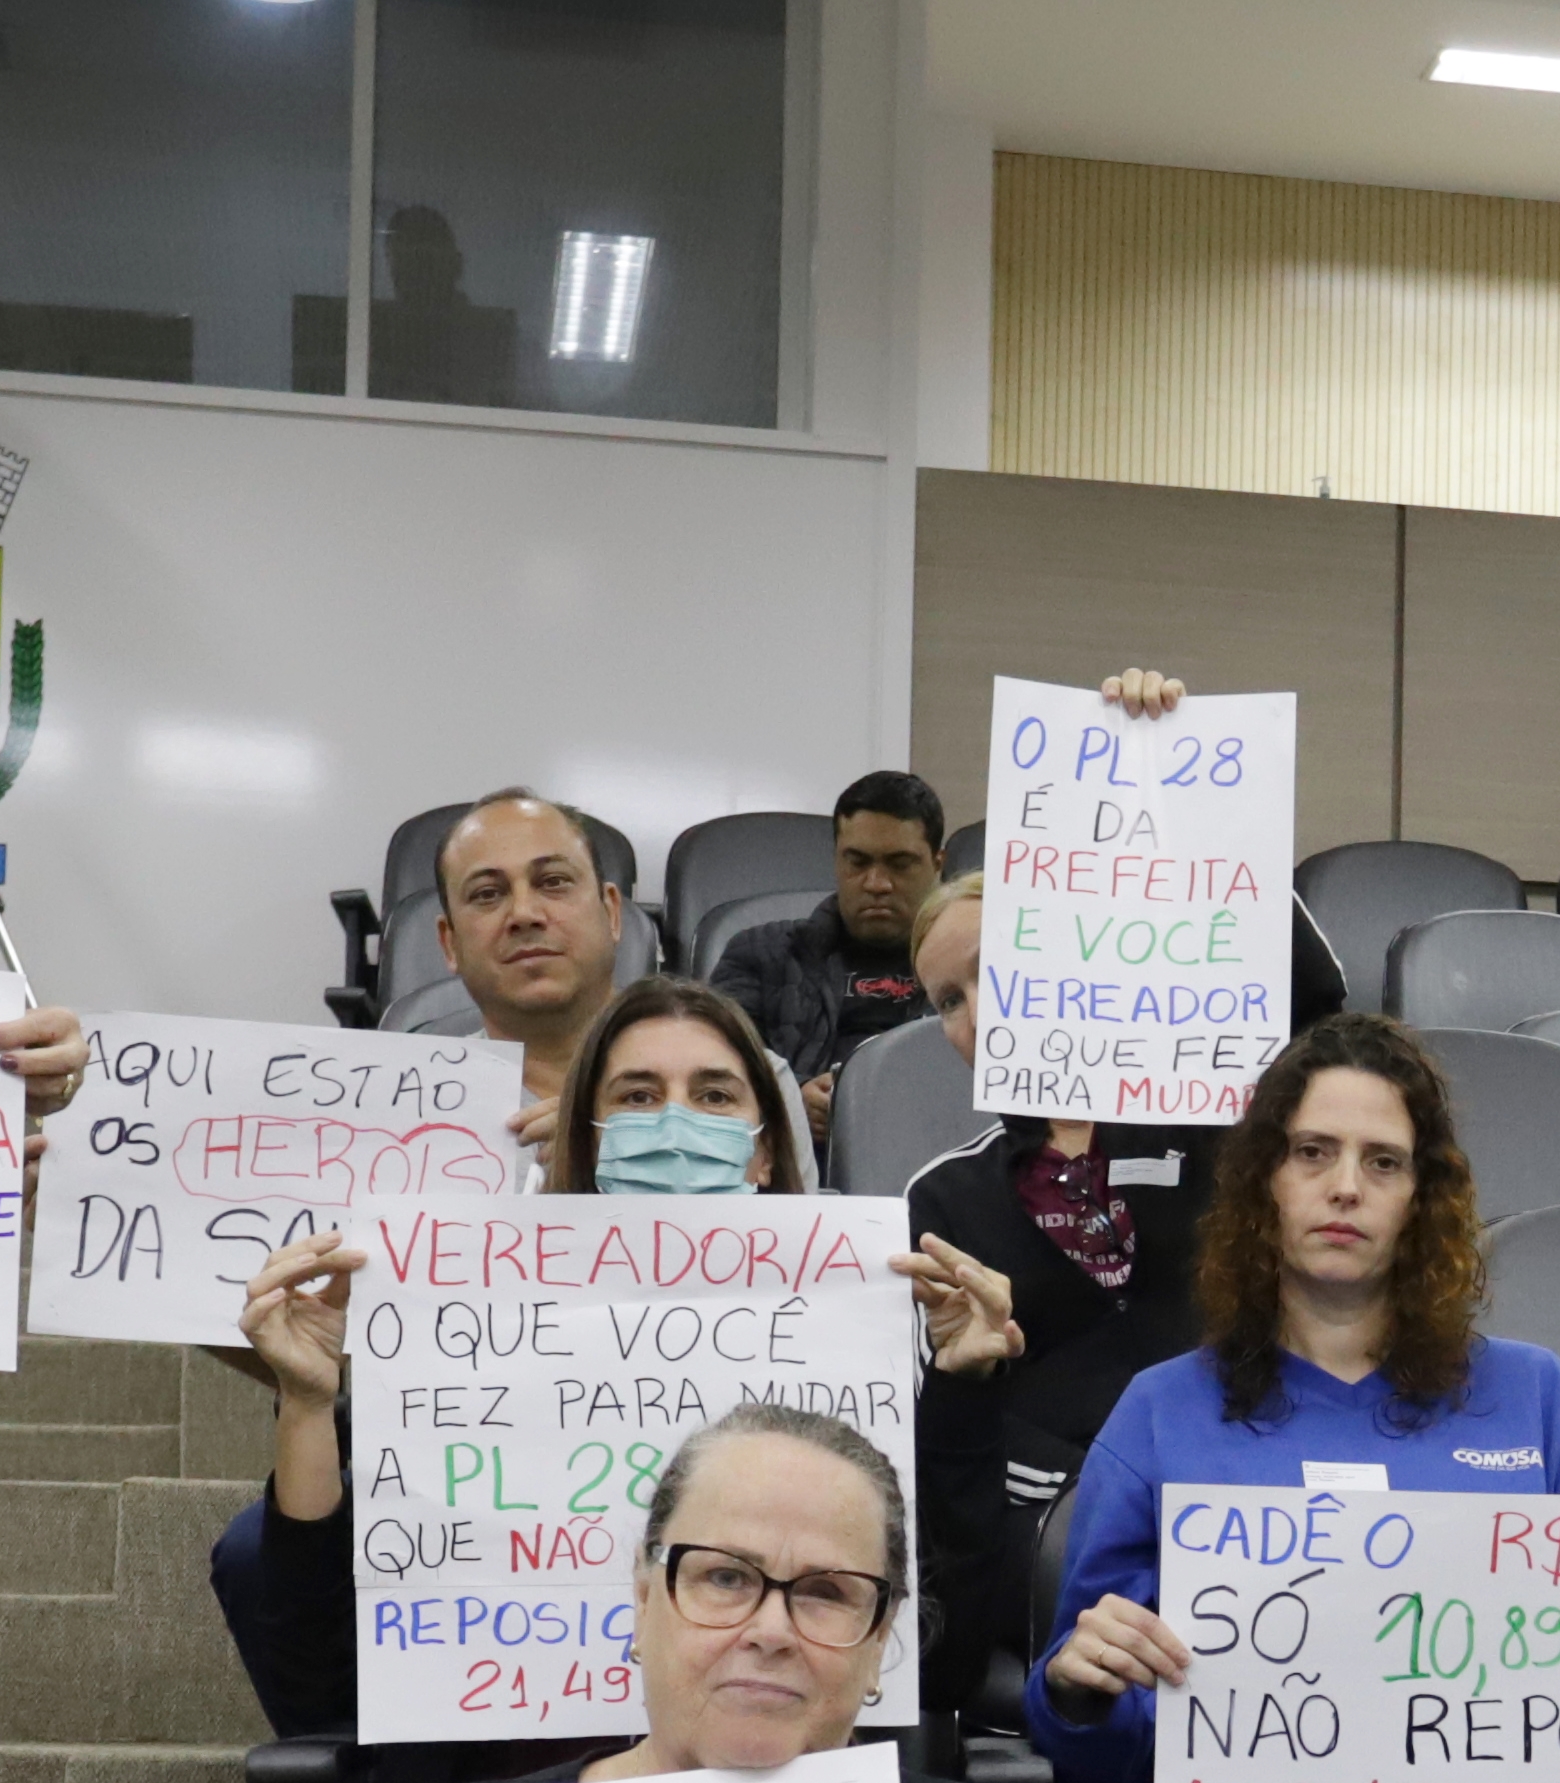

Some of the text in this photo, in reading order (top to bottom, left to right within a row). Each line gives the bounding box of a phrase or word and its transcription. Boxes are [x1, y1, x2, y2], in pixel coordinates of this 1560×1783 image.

[1011, 716, 1244, 788] O PL 28
[1020, 784, 1159, 850] É DA
[1003, 840, 1259, 904] PREFEITA
[1014, 906, 1244, 965] E VOCÊ
[987, 965, 1268, 1026] VEREADOR
[83, 1030, 213, 1107] AQUI
[986, 1026, 1282, 1076] O QUE FEZ
[983, 1067, 1092, 1111] PARA
[90, 1116, 160, 1166] OS
[70, 1194, 162, 1281] DA
[378, 1210, 865, 1289] VEREADOR/A
[366, 1297, 808, 1370] O QUE VOCÊ
[401, 1386, 514, 1429] FEZ
[558, 1378, 708, 1430] PARA
[370, 1440, 663, 1514] A PL 28
[1452, 1449, 1544, 1468] COMUSA
[365, 1515, 614, 1574] QUE NÃO
[1171, 1492, 1347, 1566] CADÊ
[1363, 1512, 1414, 1569] O
[374, 1600, 636, 1663] REPOSIÇ
[1191, 1567, 1326, 1664] SÓ
[1187, 1670, 1340, 1762] NÃO
